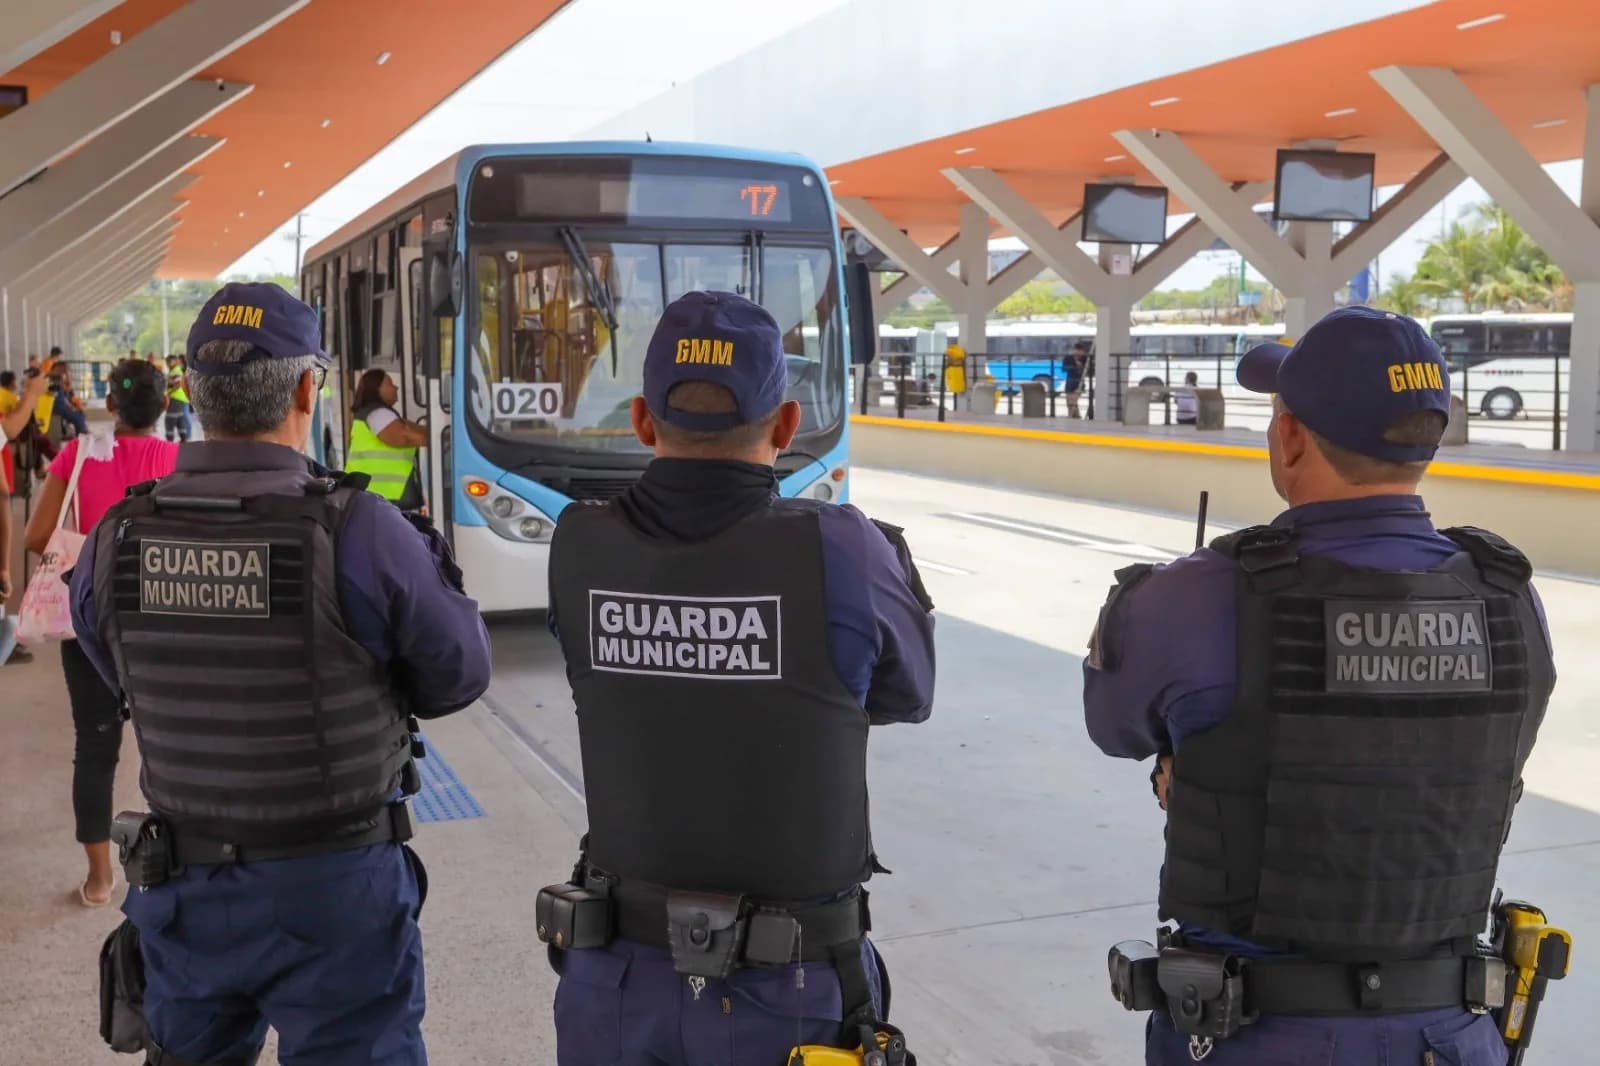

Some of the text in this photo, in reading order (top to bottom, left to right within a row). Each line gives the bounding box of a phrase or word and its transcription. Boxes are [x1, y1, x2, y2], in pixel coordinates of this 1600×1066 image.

[213, 304, 263, 328] GMM
[675, 339, 733, 366] GMM
[1387, 362, 1444, 392] GMM
[496, 387, 559, 415] 020
[144, 546, 264, 577] GUARDA
[144, 580, 265, 609] MUNICIPAL
[599, 601, 768, 640] GUARDA
[1335, 612, 1484, 648] GUARDA
[598, 636, 771, 671] MUNICIPAL
[1336, 654, 1486, 682] MUNICIPAL
